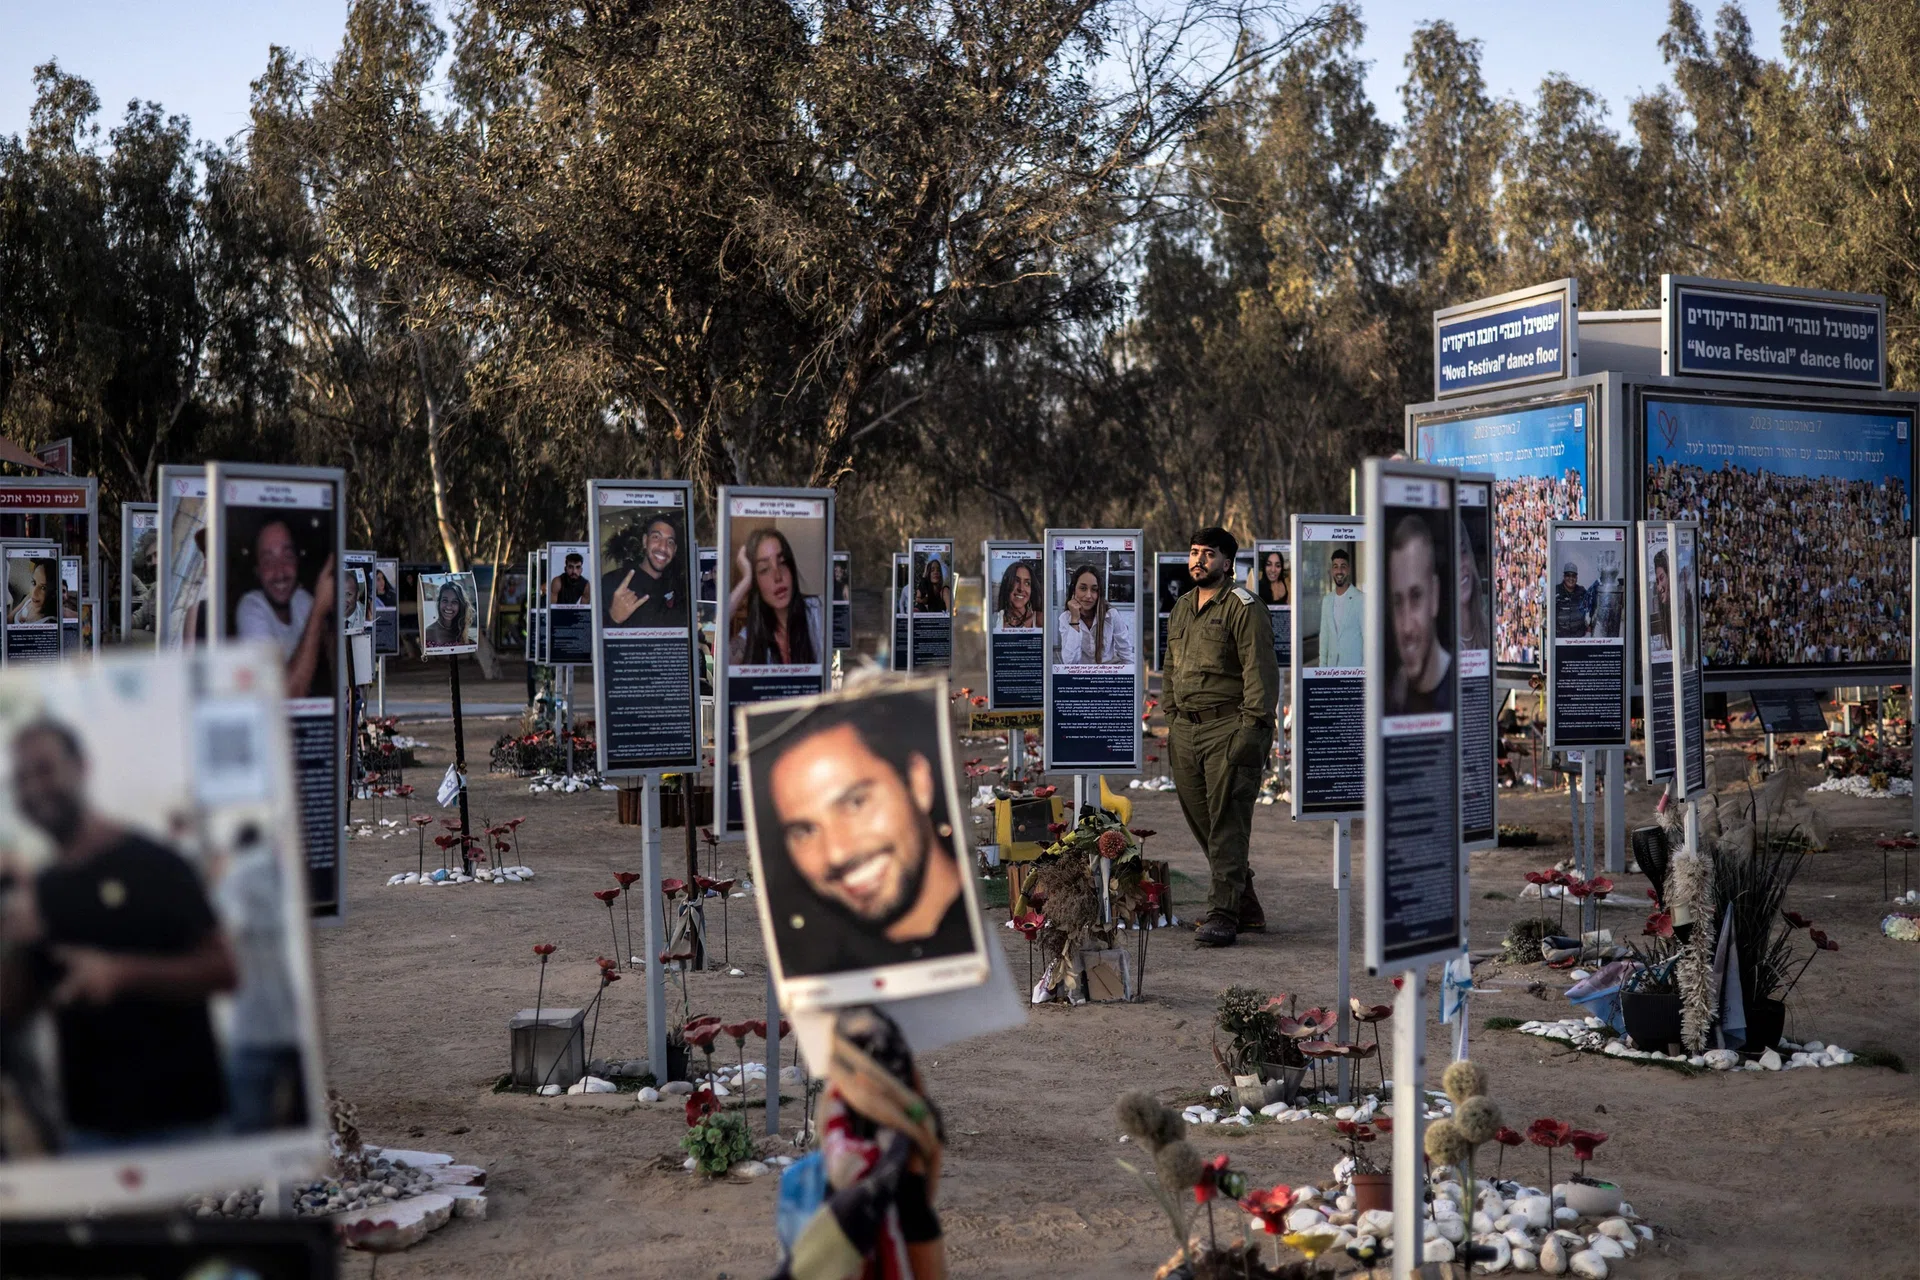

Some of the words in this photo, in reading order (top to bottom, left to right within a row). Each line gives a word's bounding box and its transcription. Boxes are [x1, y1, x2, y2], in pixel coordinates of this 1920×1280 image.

[1688, 307, 1746, 330] הריקודים
[1750, 313, 1784, 332] רחבת
[1442, 330, 1476, 352] הריקודים
[1477, 326, 1498, 346] רחבת
[1507, 352, 1534, 370] dance
[1536, 347, 1559, 364] floor
[1735, 343, 1796, 364] Festival”
[1800, 349, 1840, 368] dance
[1844, 352, 1874, 371] floor
[1750, 416, 1772, 430] 2023
[1774, 420, 1815, 434] באוקטובר
[1816, 420, 1822, 432] 7
[1534, 446, 1549, 457] נזכור
[1550, 441, 1565, 456] לנצח
[1706, 444, 1734, 456] שנדמו
[1738, 445, 1773, 458] והשמחה
[1776, 448, 1797, 459] האור
[1800, 450, 1812, 460] עם
[1843, 450, 1863, 462] נזכור
[1865, 450, 1884, 462] לנצח
[26, 494, 50, 503] נזכור
[54, 492, 79, 503] לנצח
